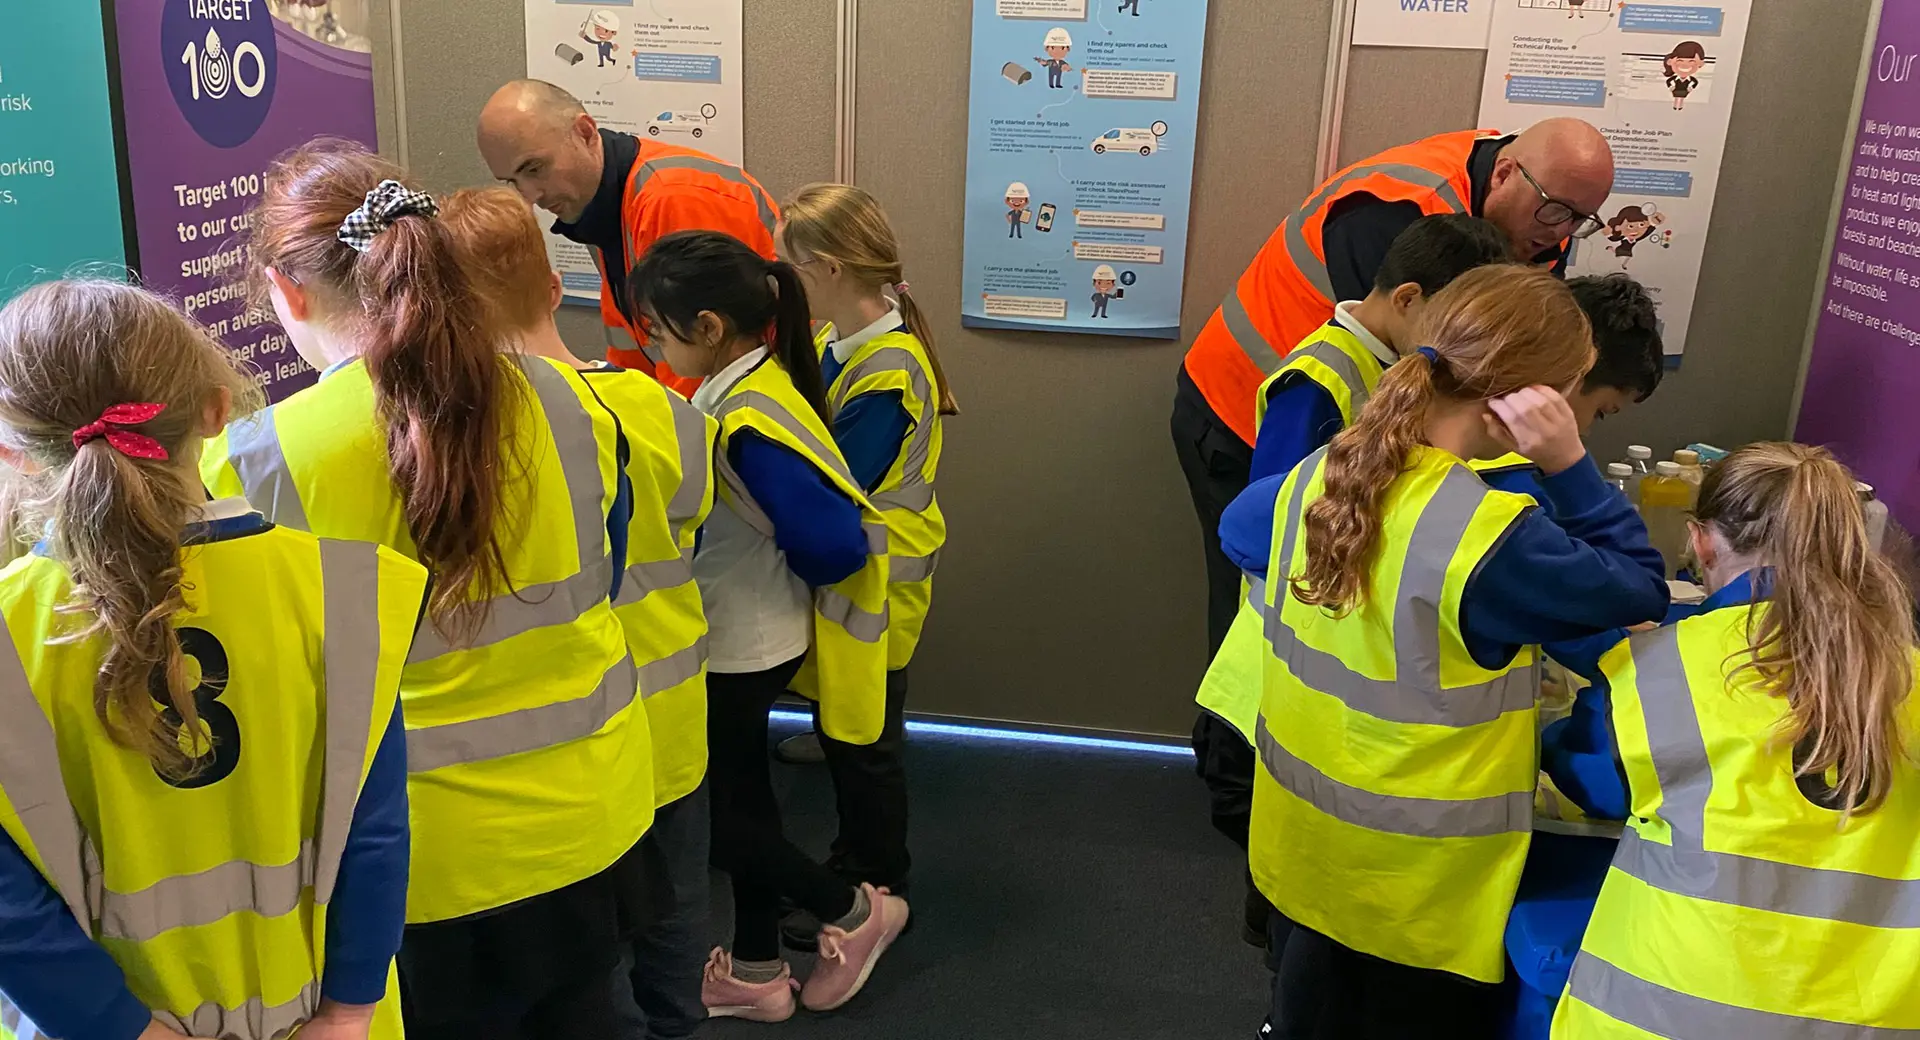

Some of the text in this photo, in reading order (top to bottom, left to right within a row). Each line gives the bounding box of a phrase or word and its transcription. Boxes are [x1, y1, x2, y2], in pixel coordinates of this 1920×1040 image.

[189, 0, 252, 20] TARGET
[1400, 0, 1469, 13] WATER
[1878, 45, 1918, 82] Our
[1, 93, 33, 111] risk
[1612, 135, 1658, 143] Dependencies
[1864, 119, 1877, 134] We
[1877, 121, 1894, 139] rely
[1894, 125, 1907, 137] on
[1881, 143, 1894, 158] for
[1855, 164, 1870, 178] and
[1870, 165, 1879, 179] to
[1880, 166, 1900, 186] help
[173, 180, 227, 208] Target
[230, 174, 259, 198] 100
[1851, 183, 1862, 198] for
[1861, 186, 1880, 202] heat
[1880, 192, 1900, 206] and
[1845, 207, 1880, 226] products
[1881, 215, 1896, 228] we
[177, 222, 197, 243] to
[201, 217, 226, 238] our
[1842, 225, 1867, 245] forests
[1867, 235, 1887, 249] and
[181, 245, 243, 279] support
[1837, 251, 1920, 288] Without water, life as
[1832, 271, 1889, 302] be impossible.
[1826, 299, 1843, 316] And
[1842, 304, 1864, 324] there
[1864, 315, 1881, 330] are
[260, 333, 288, 354] day
[147, 626, 241, 790] 8
